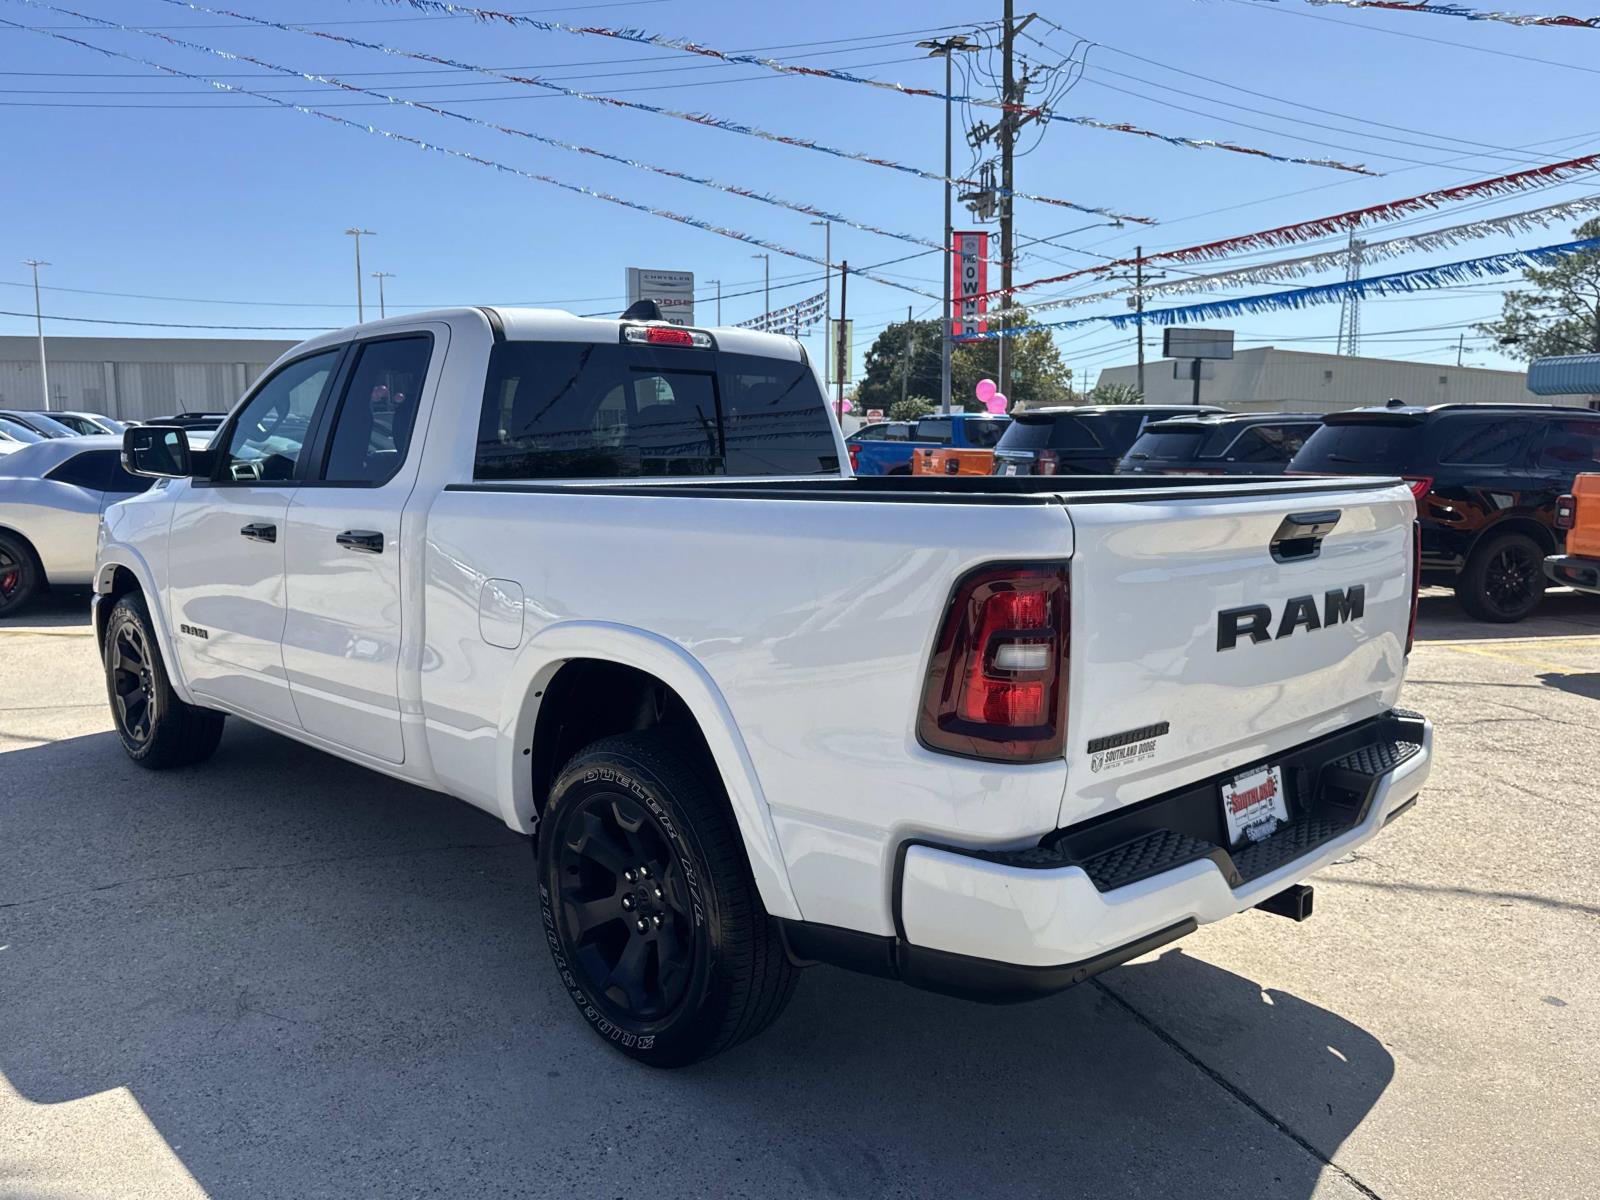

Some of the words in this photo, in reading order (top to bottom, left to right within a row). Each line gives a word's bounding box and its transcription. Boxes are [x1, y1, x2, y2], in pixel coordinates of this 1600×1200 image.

[650, 298, 691, 306] ODGE
[180, 623, 208, 640] RAM
[1217, 584, 1365, 652] RAM
[1105, 745, 1138, 763] SOUTHLAND
[583, 767, 678, 839] DUELER
[539, 882, 656, 1050] BRIDGESTONE
